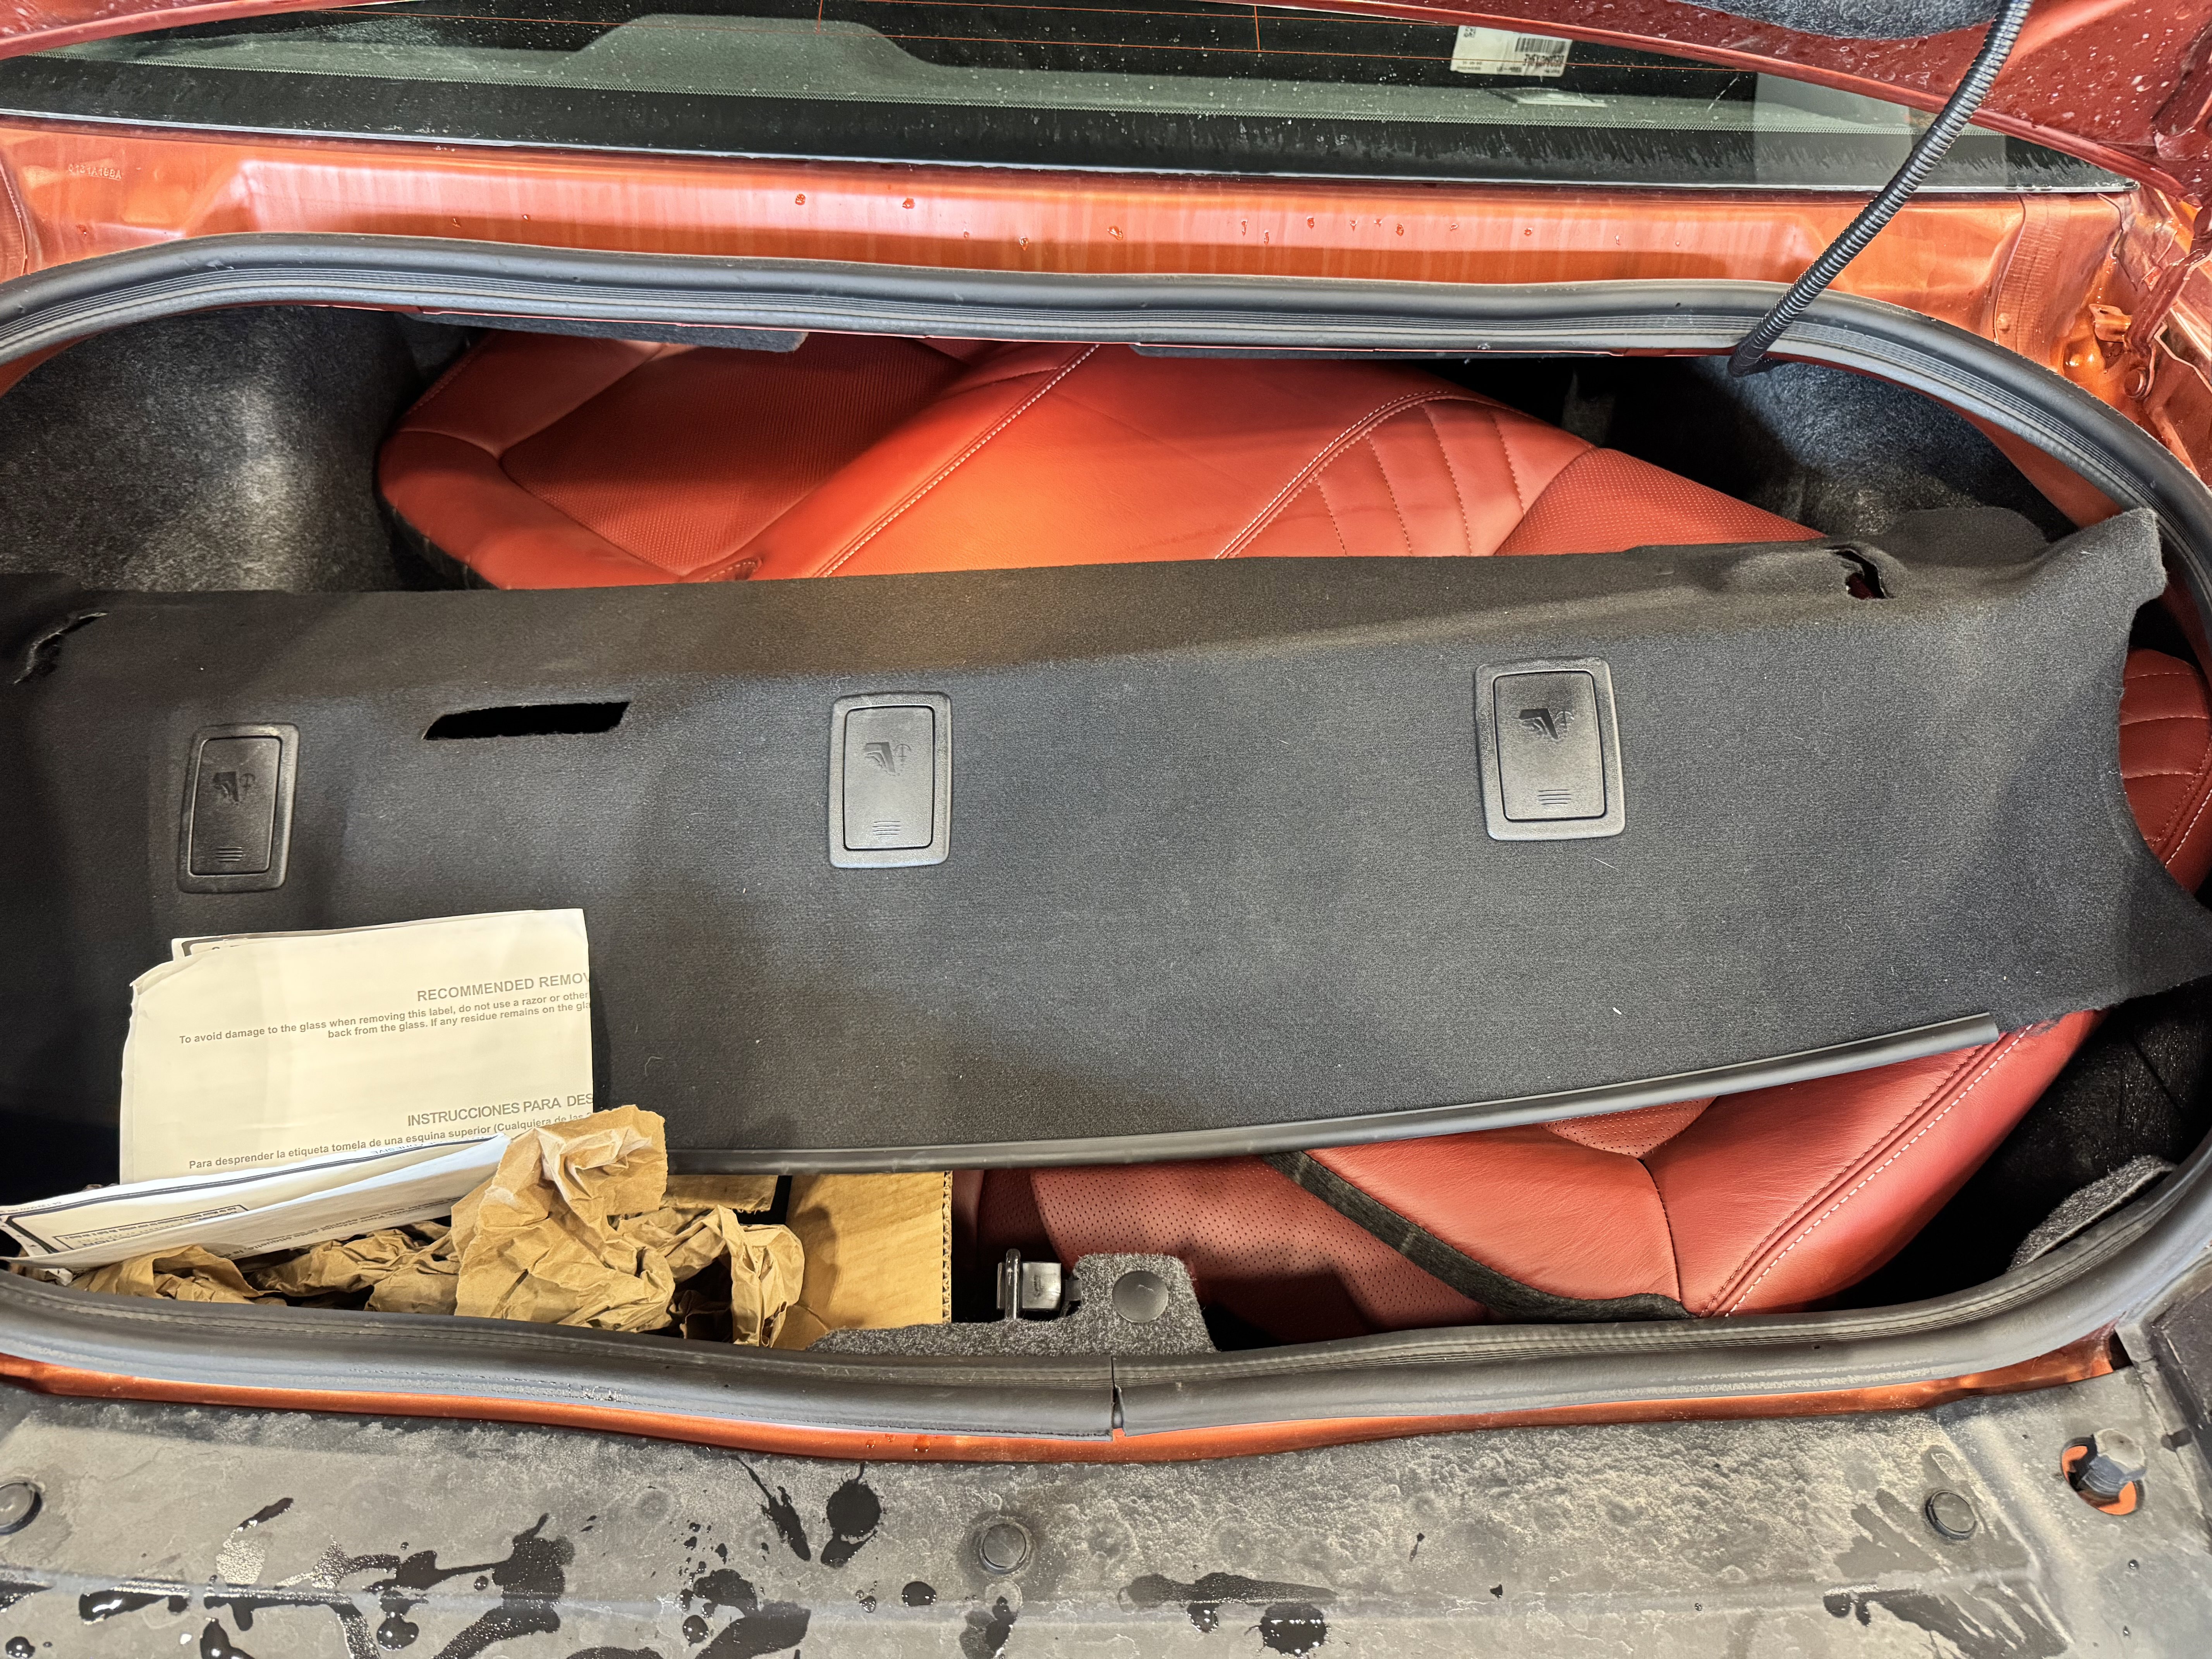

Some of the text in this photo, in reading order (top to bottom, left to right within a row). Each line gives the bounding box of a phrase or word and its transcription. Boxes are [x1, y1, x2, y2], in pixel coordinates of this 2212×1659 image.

[417, 978, 534, 1002] RECOMMENDED
[179, 1035, 192, 1044] To
[194, 1031, 222, 1042] avoid
[225, 1029, 265, 1039] damage
[280, 1024, 297, 1032] the
[299, 1022, 327, 1032] glass
[329, 1018, 356, 1027] when
[359, 1013, 405, 1024] removing
[407, 1009, 426, 1018] this
[429, 1006, 456, 1016] label,
[459, 1004, 471, 1013] do
[474, 1002, 491, 1011] not
[522, 996, 547, 1005] razor
[563, 992, 589, 1001] other
[328, 1028, 352, 1038] back
[354, 1027, 378, 1035] from
[380, 1024, 396, 1032] the
[399, 1021, 428, 1032] glass.
[431, 1018, 438, 1027] If
[440, 1018, 458, 1026] any
[460, 1012, 497, 1023] residue
[500, 1008, 539, 1018] remains
[557, 1003, 573, 1012] the
[408, 1093, 593, 1127] INSTRUCCIONES PARA DES
[189, 1160, 212, 1169] Para
[215, 1152, 274, 1166] desprender
[276, 1150, 285, 1159] la
[288, 1146, 329, 1158] etiqueta
[331, 1140, 366, 1151] tomela
[369, 1139, 381, 1147] de
[384, 1137, 403, 1146] una
[405, 1131, 446, 1143] esquina
[448, 1125, 491, 1138] superior
[493, 1118, 551, 1133] (Cualquiera
